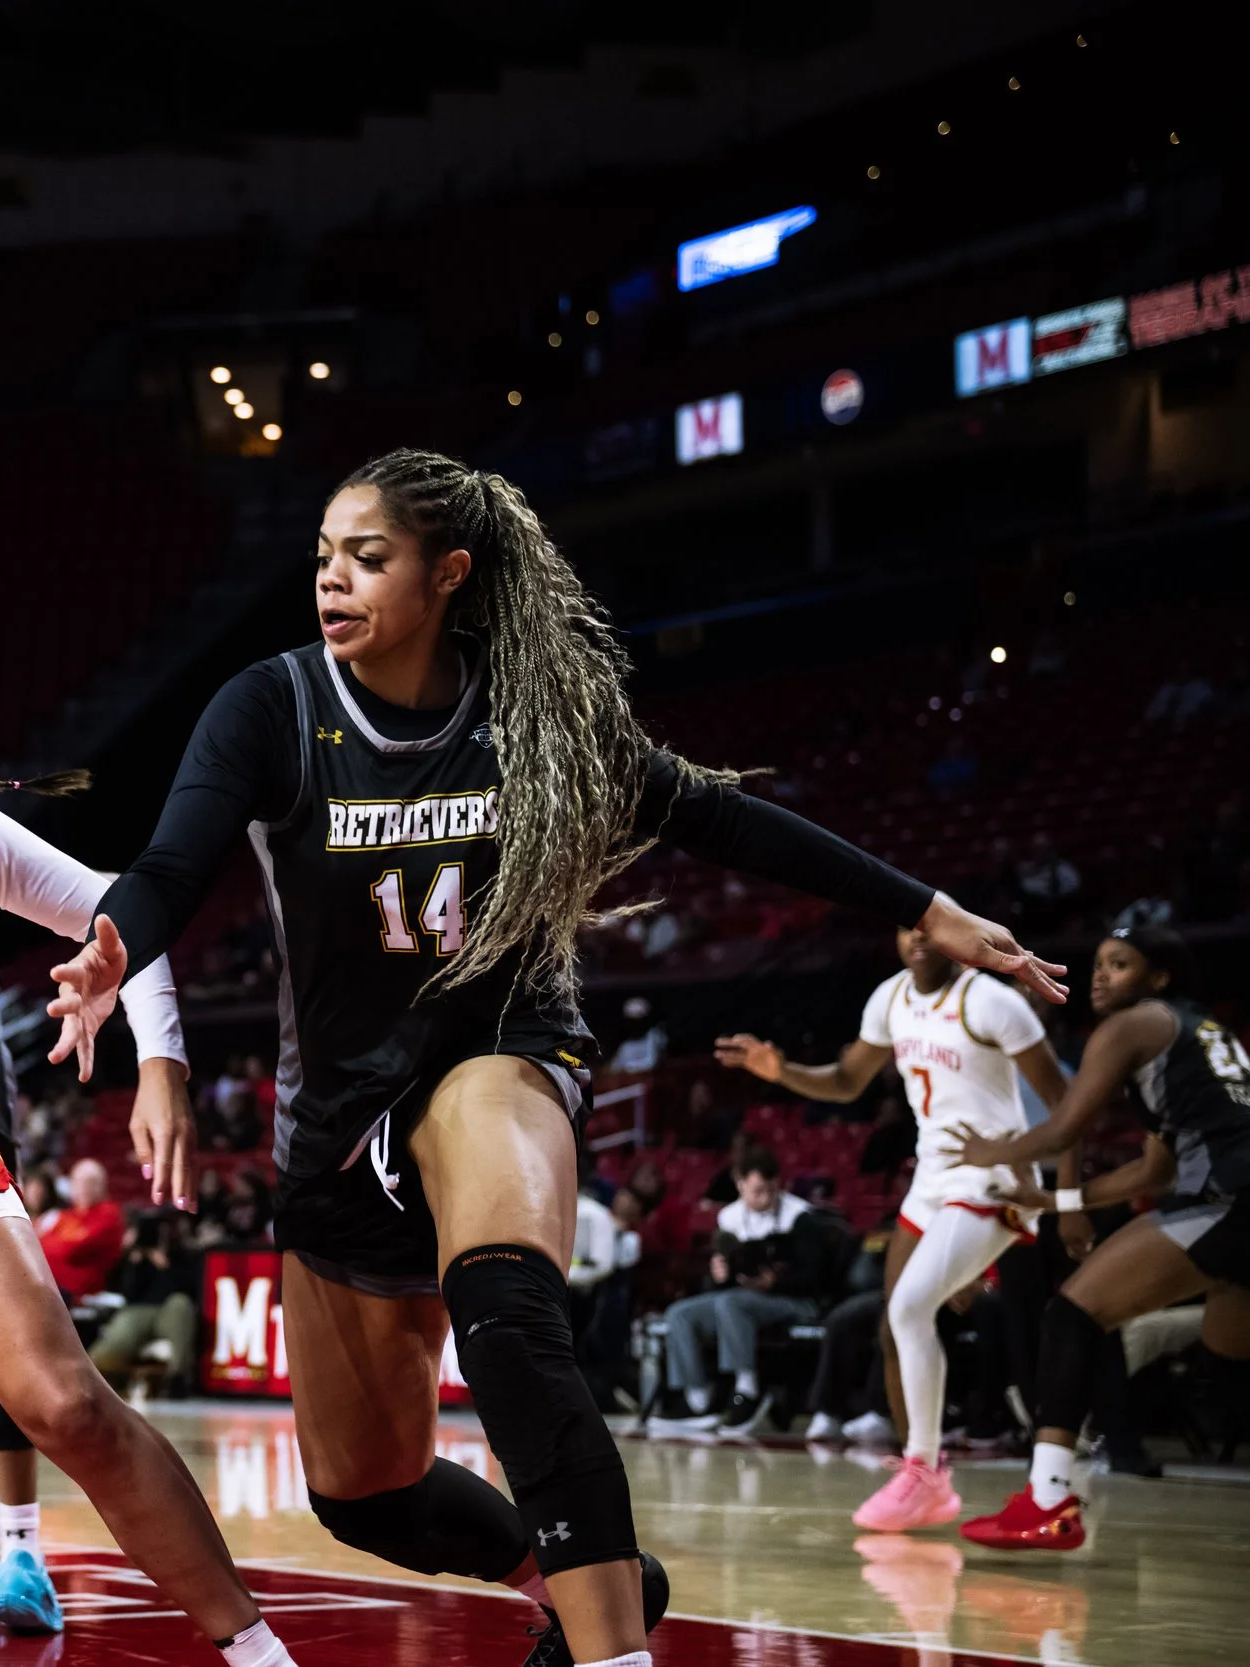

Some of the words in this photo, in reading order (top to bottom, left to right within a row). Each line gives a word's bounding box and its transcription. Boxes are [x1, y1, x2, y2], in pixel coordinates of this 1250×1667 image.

[328, 789, 499, 850] RETRIEVERS
[371, 862, 467, 957] 14
[911, 1067, 932, 1117] 7
[212, 1276, 272, 1366] M
